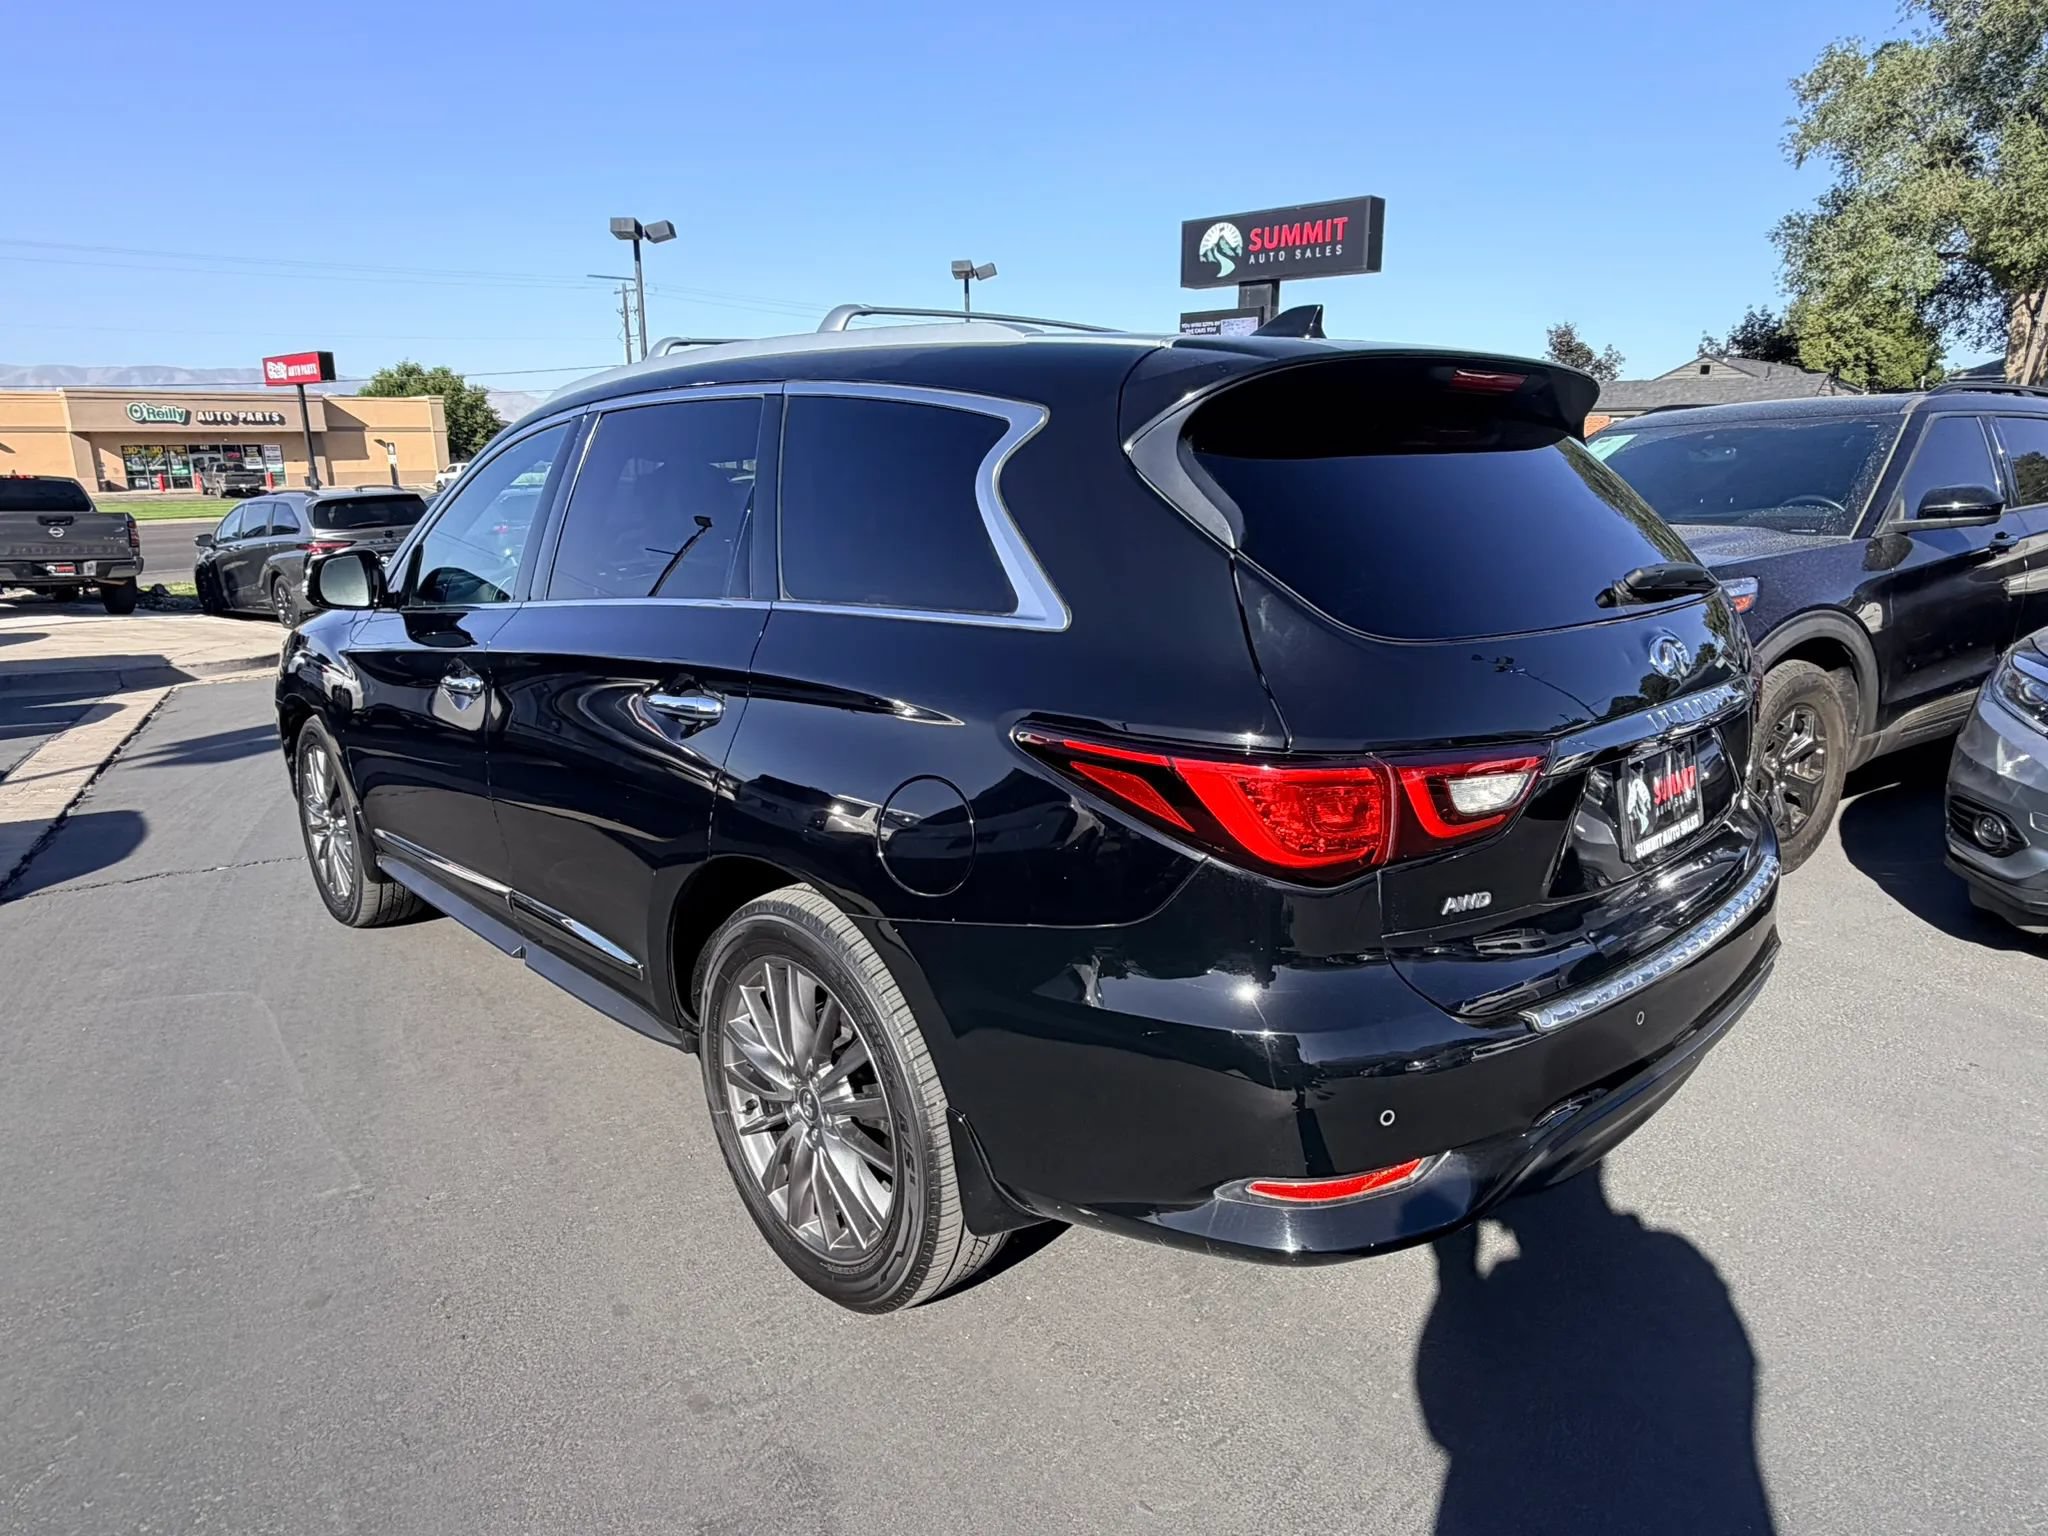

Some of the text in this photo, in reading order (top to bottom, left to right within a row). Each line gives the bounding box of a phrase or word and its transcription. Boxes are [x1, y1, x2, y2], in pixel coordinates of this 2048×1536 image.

[1248, 216, 1349, 252] SUMMIT
[1249, 244, 1343, 264] AUTO SALES
[127, 402, 280, 423] O'Reilly AUTO PARTS
[1635, 814, 1700, 859] SUMMIT AUTO SALES
[1441, 891, 1492, 916] AWD
